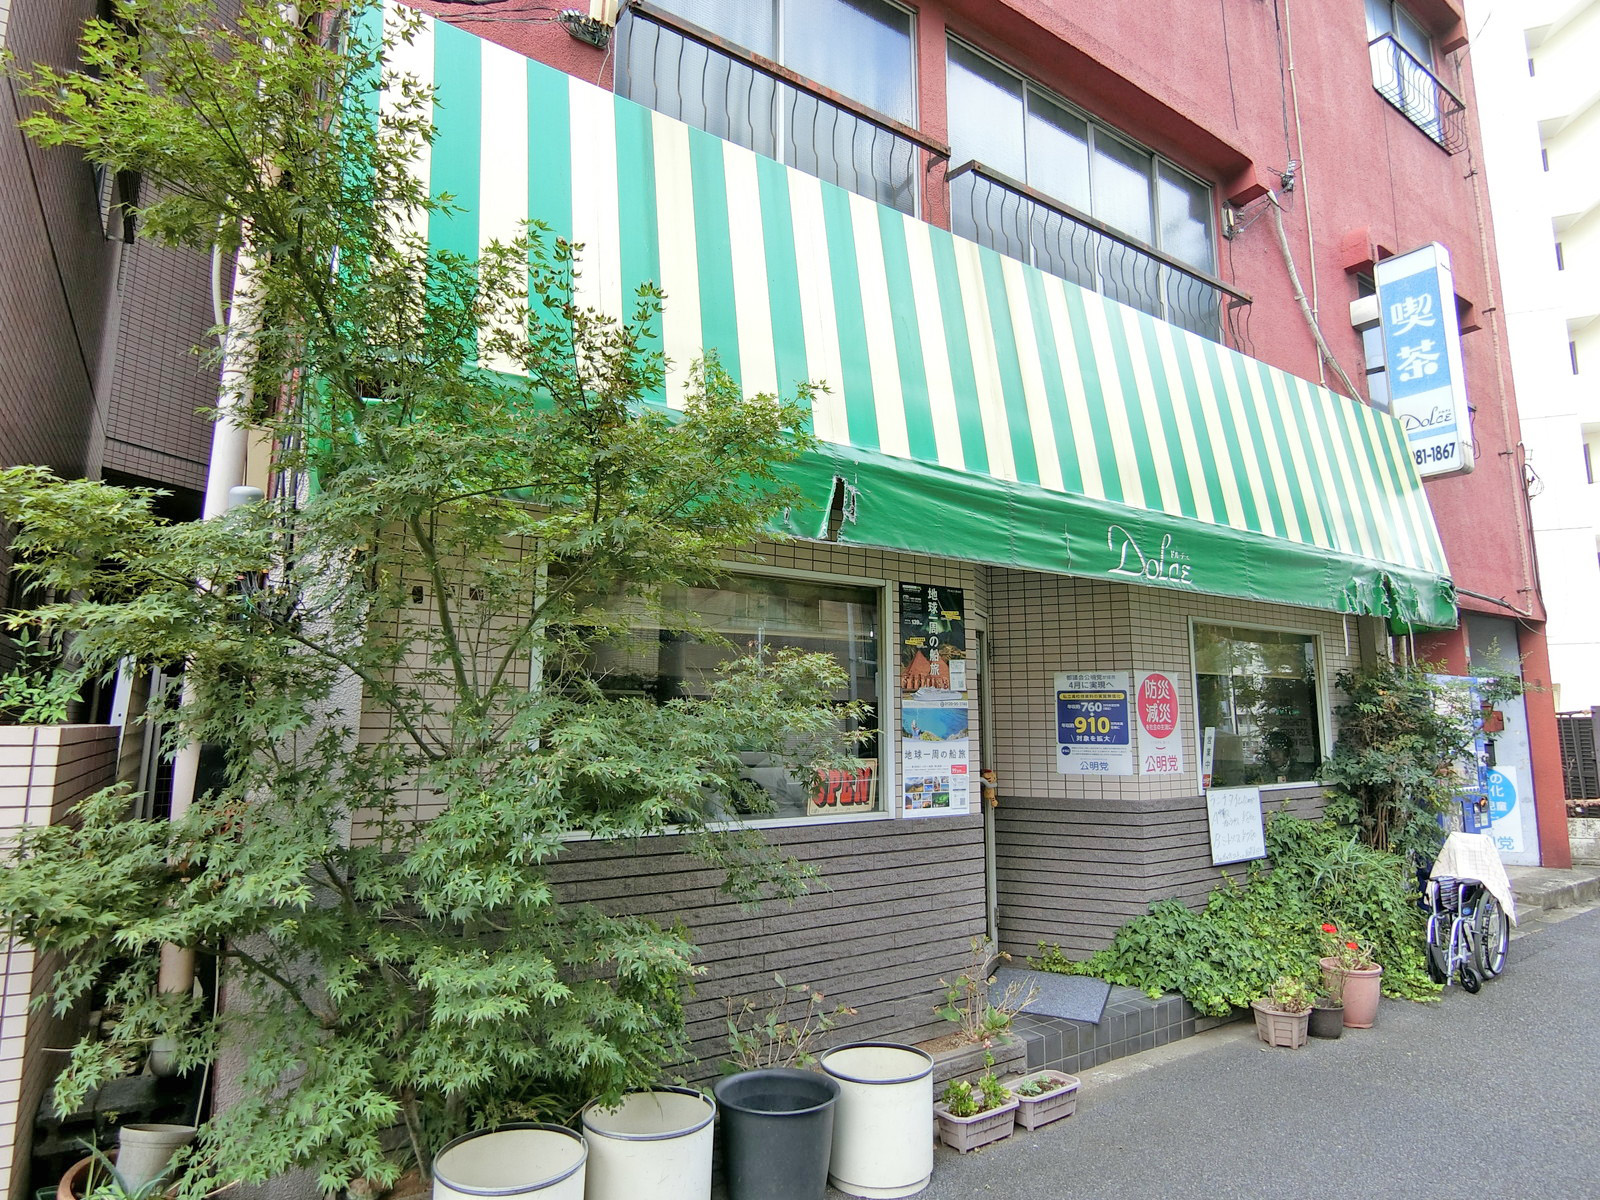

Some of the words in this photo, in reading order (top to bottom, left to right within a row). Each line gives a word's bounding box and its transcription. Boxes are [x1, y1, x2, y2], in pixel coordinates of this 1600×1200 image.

[1390, 293, 1440, 382] 喫茶
[1412, 442, 1456, 466] 81-1867
[927, 587, 940, 676] 地球一周の船旅
[1068, 681, 1114, 689] 4月に実現へ
[1080, 702, 1103, 712] 760
[1145, 703, 1172, 723] 減災
[1074, 716, 1110, 734] 910
[904, 749, 966, 760] 地球一周の船旅
[1205, 736, 1213, 770] 営業中
[1080, 761, 1109, 771] 公明党
[1145, 755, 1179, 772] 公明党
[1490, 773, 1503, 784] の
[1490, 785, 1505, 797] 化
[1493, 836, 1514, 850] 党
